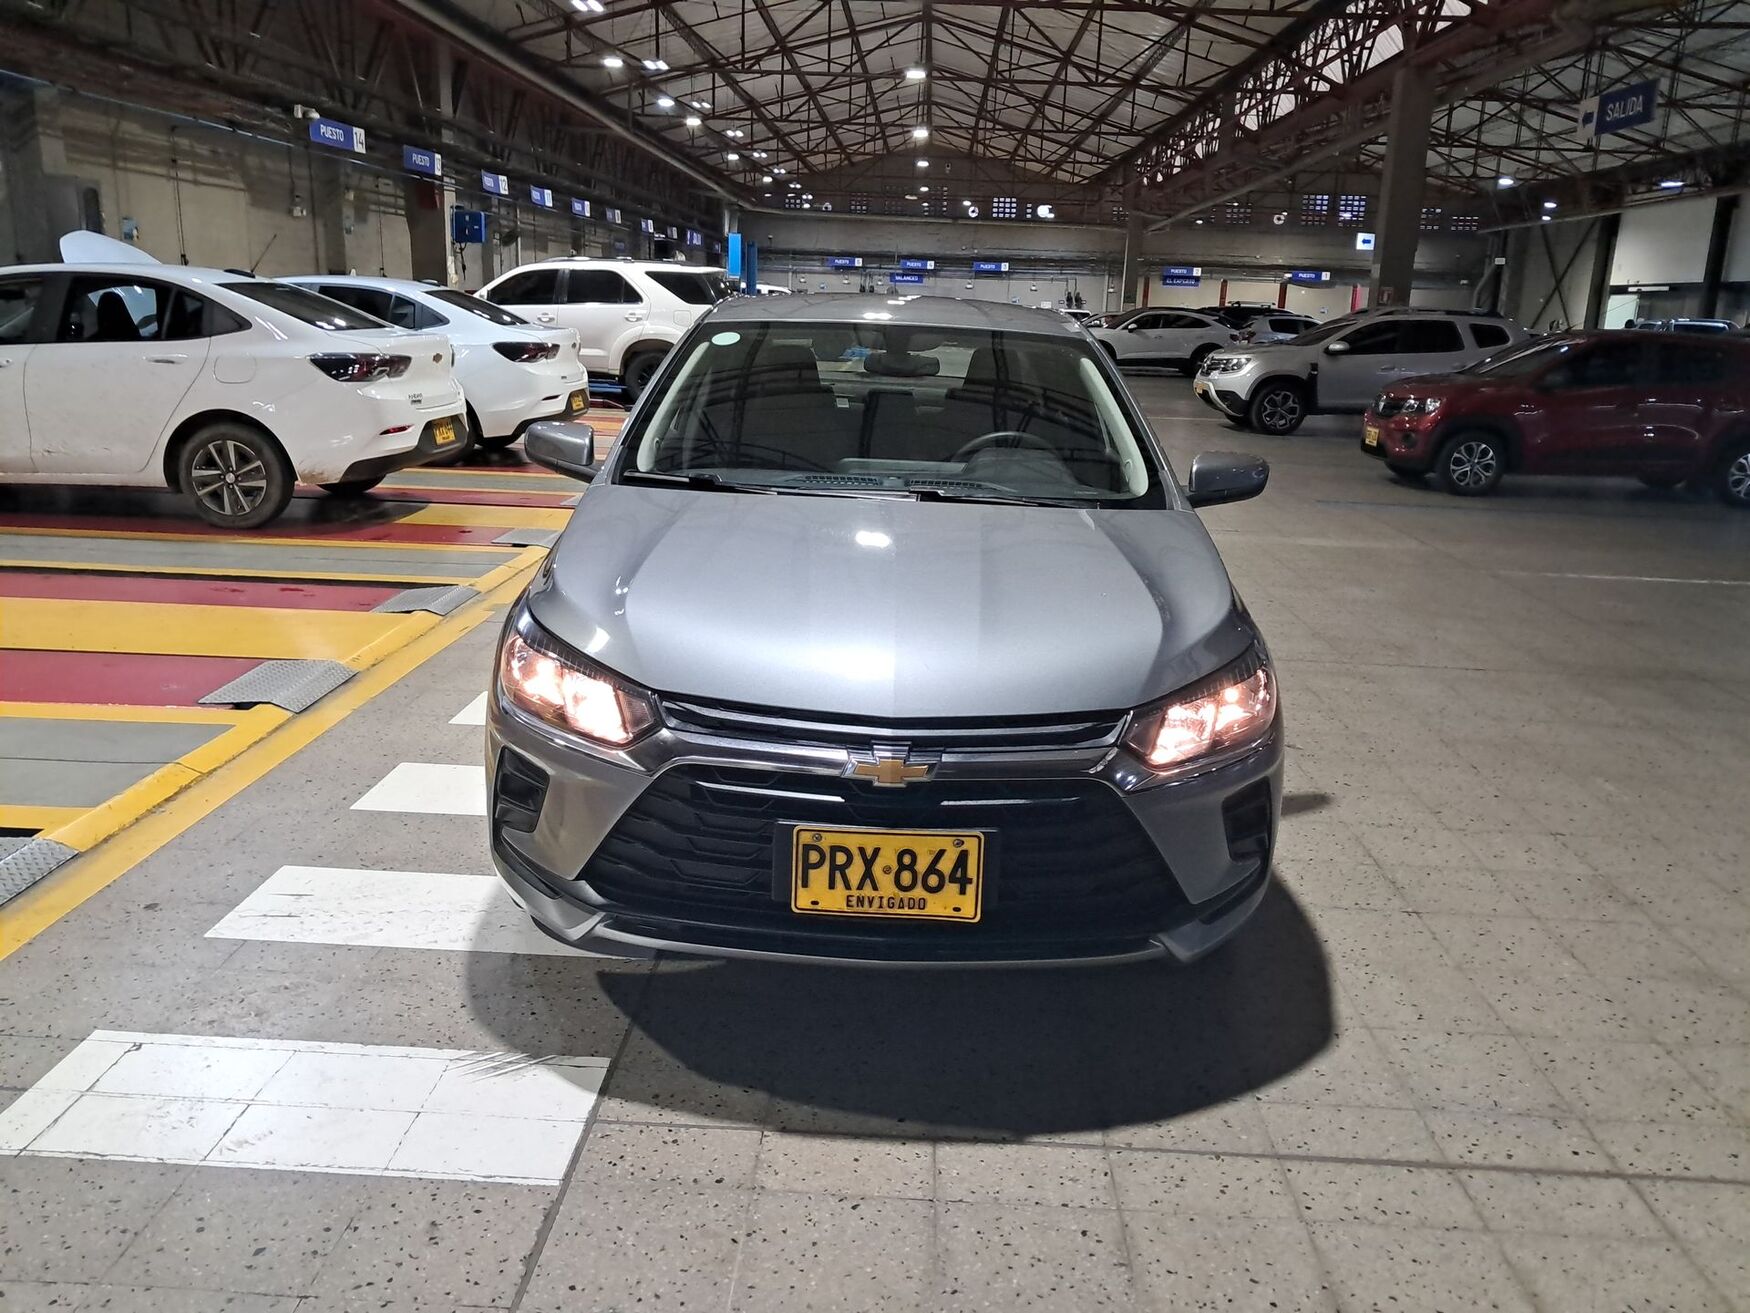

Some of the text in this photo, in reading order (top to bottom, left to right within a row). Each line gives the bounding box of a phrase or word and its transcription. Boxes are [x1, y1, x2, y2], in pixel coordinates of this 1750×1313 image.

[1605, 94, 1643, 121] SALIDA
[319, 124, 364, 148] PUESTO 14
[412, 153, 430, 167] PUESTO
[500, 178, 508, 192] 12
[800, 843, 973, 896] PRX 864
[845, 894, 927, 911] ENVIGADO
